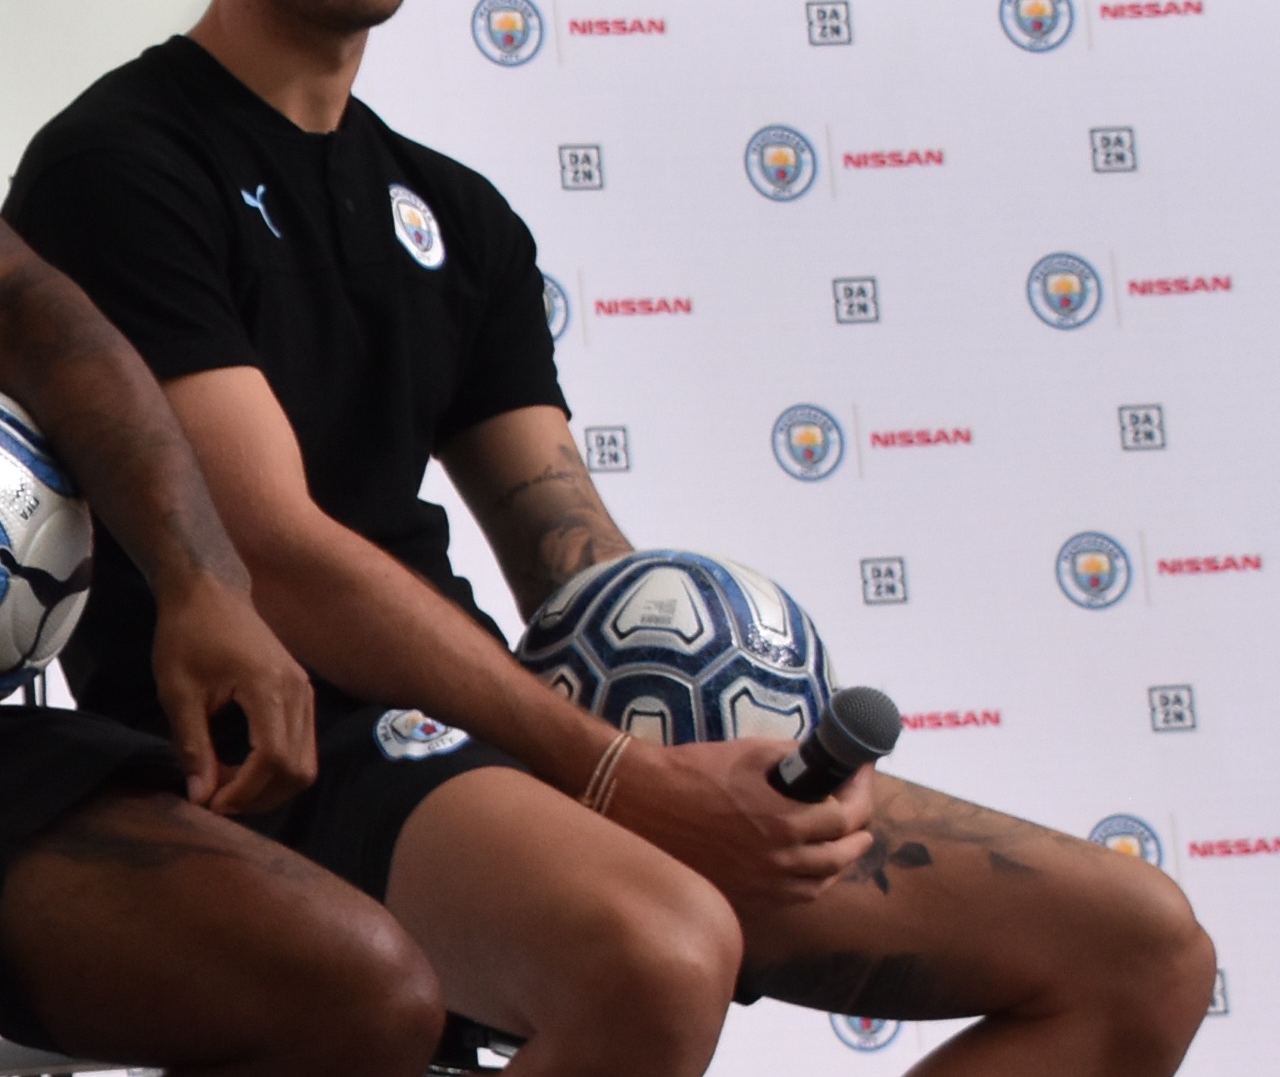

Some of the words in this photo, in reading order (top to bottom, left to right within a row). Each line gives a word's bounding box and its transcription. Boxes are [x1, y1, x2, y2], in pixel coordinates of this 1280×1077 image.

[1099, 0, 1203, 19] NISSAN
[568, 18, 665, 36] NISSAN
[842, 150, 944, 169] NISSAN
[1127, 276, 1231, 296] NISSAN
[594, 298, 692, 316] NISSAN
[869, 428, 972, 448] NISSAN
[1156, 555, 1262, 576] NISSAN
